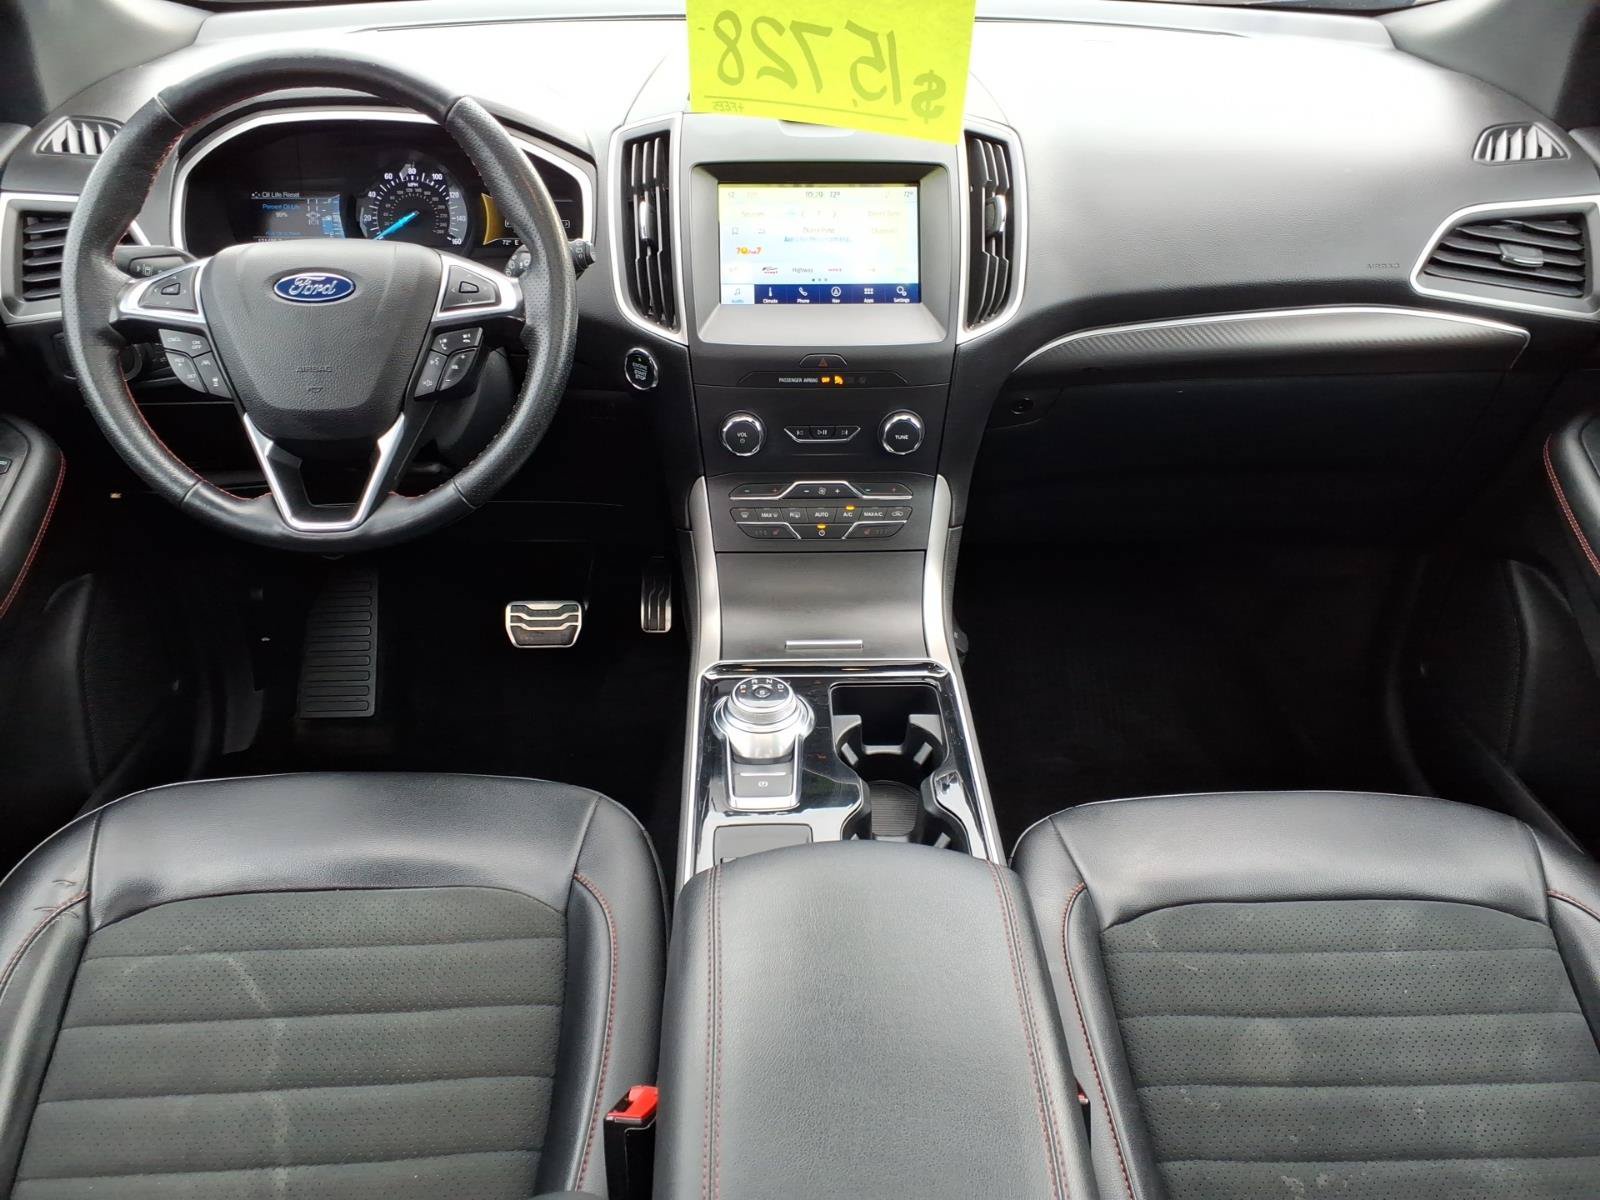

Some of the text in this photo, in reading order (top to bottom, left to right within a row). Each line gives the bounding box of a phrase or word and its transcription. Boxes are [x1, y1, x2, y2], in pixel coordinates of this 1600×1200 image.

[363, 214, 372, 222] 20
[289, 276, 337, 296] Ford
[297, 364, 332, 373] AIRBAG
